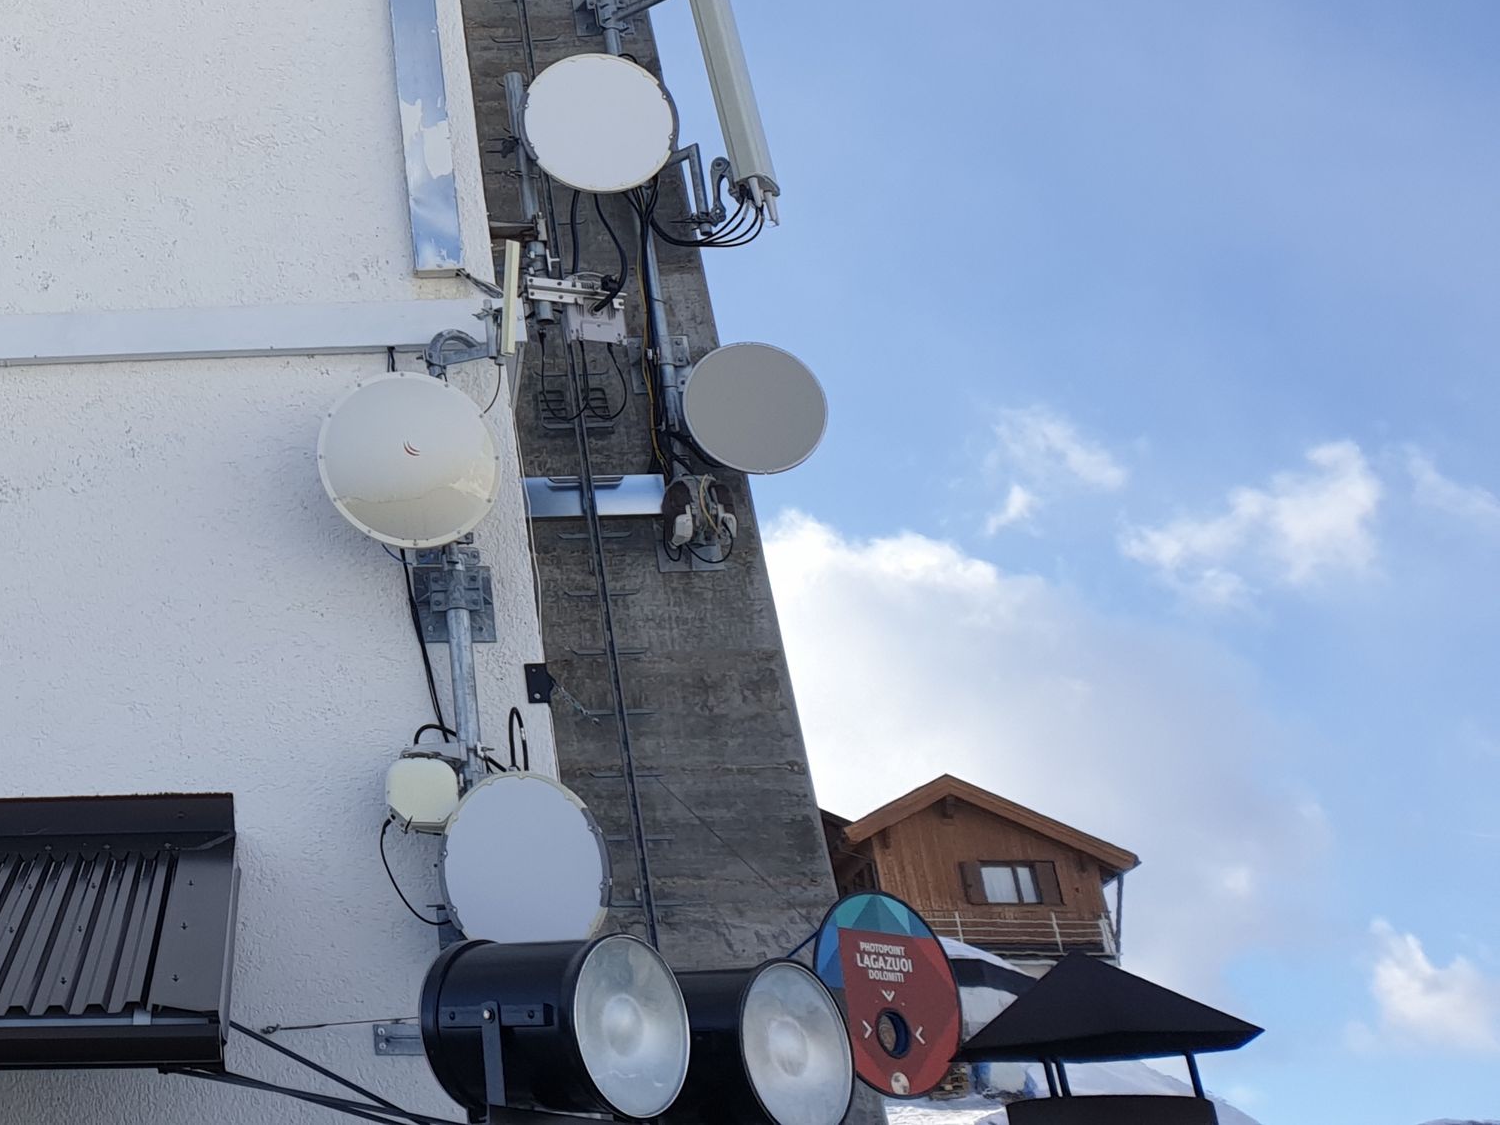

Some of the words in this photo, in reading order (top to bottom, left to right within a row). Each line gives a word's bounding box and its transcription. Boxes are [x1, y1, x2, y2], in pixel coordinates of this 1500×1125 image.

[859, 941, 905, 956] PHOTOPOINT
[855, 953, 913, 973] LAGAZUOI
[868, 969, 905, 983] DOLOMITI
